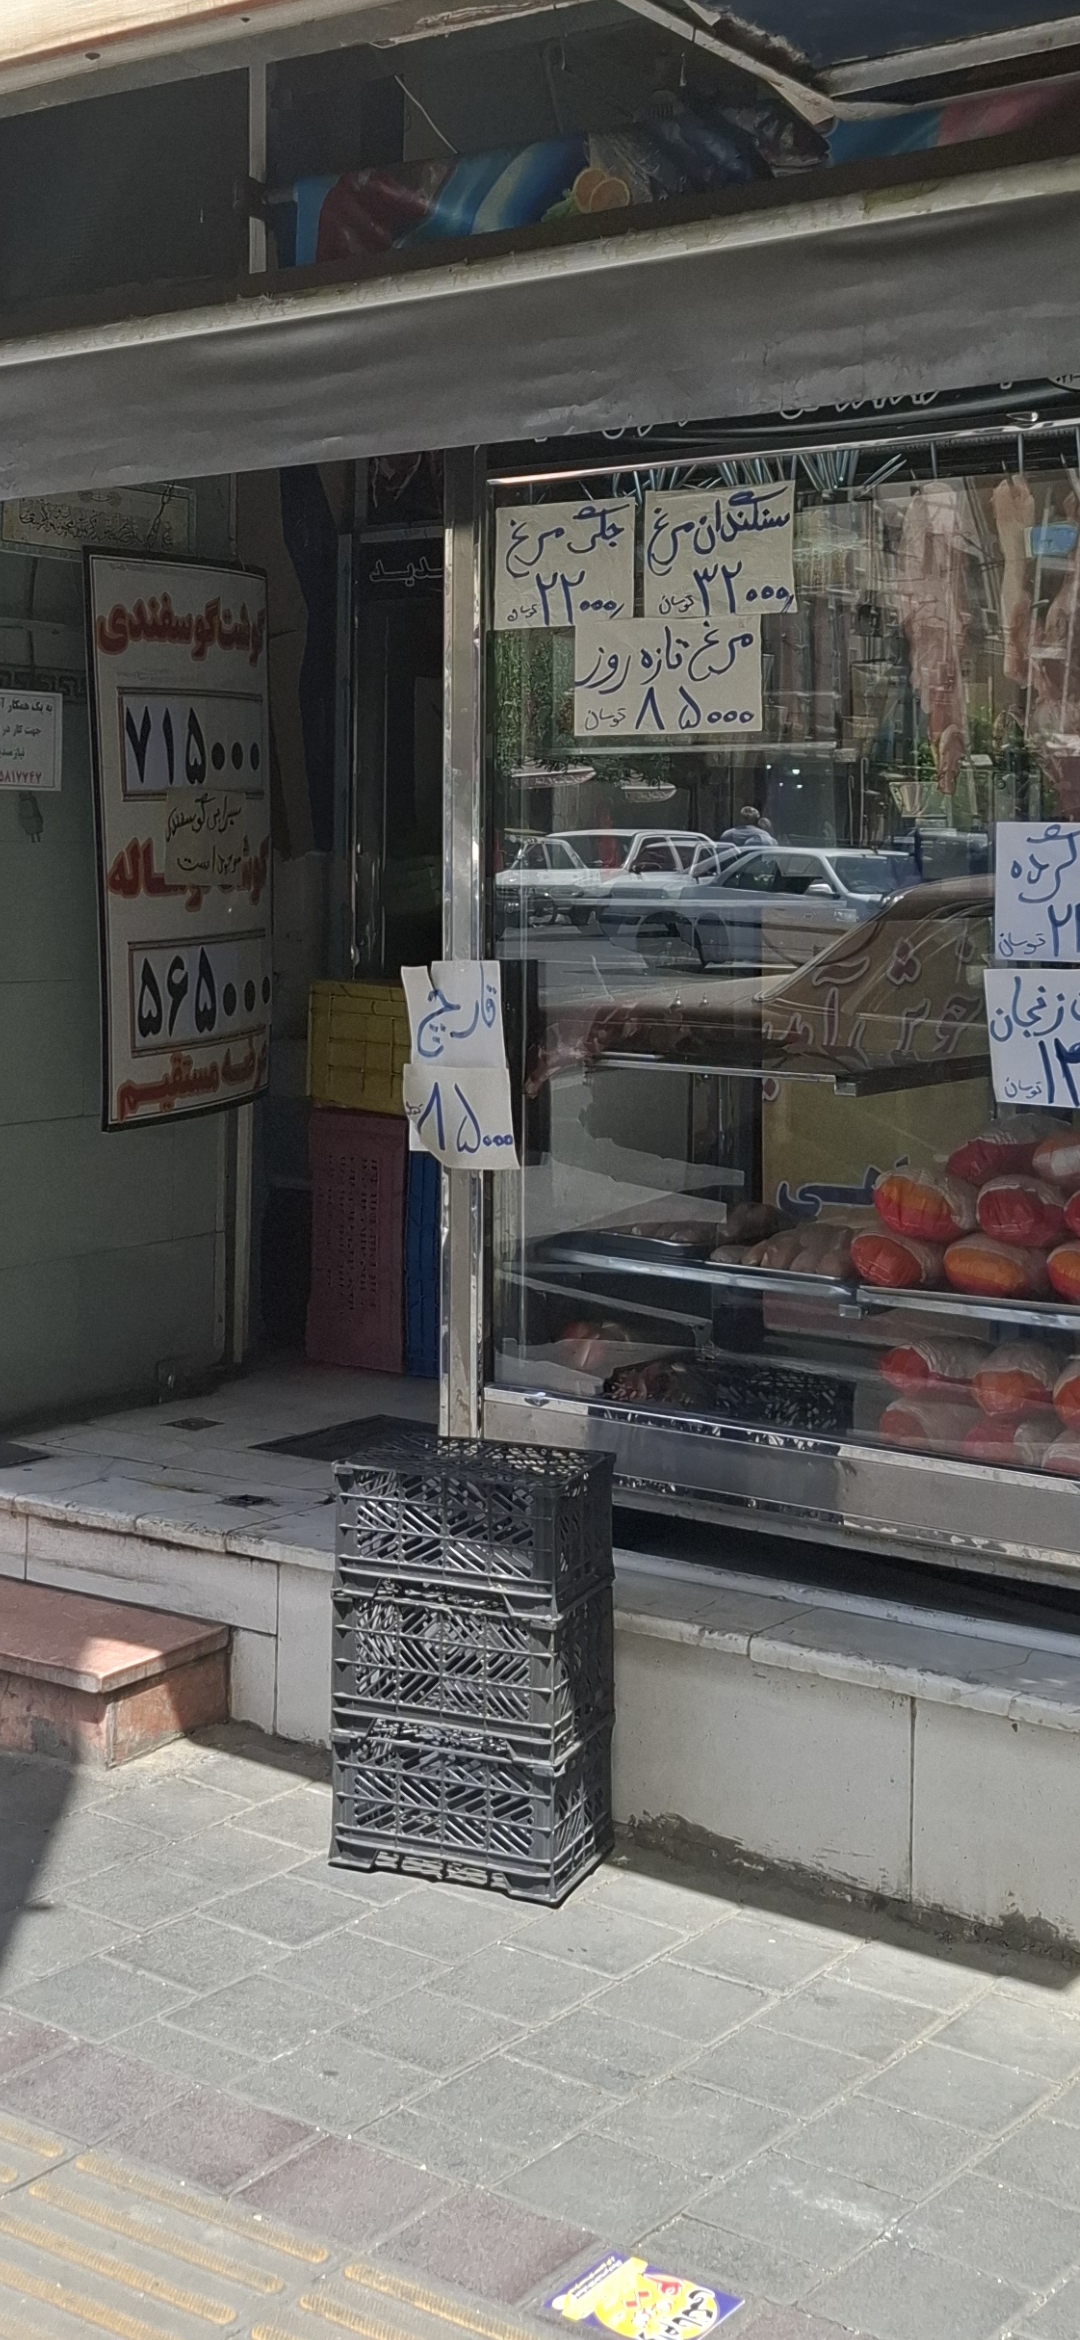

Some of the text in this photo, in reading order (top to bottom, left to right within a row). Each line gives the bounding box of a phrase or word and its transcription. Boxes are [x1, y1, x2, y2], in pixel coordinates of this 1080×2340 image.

[505, 503, 630, 579] جگر مرغ
[647, 507, 695, 577] مرغ
[97, 591, 267, 668] گوشت گوسفندی
[658, 594, 695, 615] تومان
[573, 620, 754, 695] مرغ تازه روز
[7, 699, 29, 713] همکار
[31, 701, 43, 715] یک
[45, 703, 53, 716] به
[584, 685, 755, 731] ۸۵۰۰۰ تومان
[125, 705, 260, 786] ۷۱۵۰۰۰
[177, 846, 216, 872] است
[998, 902, 1080, 958] ۲ تومان
[137, 946, 271, 1038] ۵۶۵۰۰۰
[417, 960, 498, 1058] قارچ
[990, 975, 1066, 1042] زنجان
[117, 1050, 221, 1123] مستقیم
[417, 1081, 514, 1153] ۸۵۰۰۰
[1004, 1077, 1042, 1099] تومان
